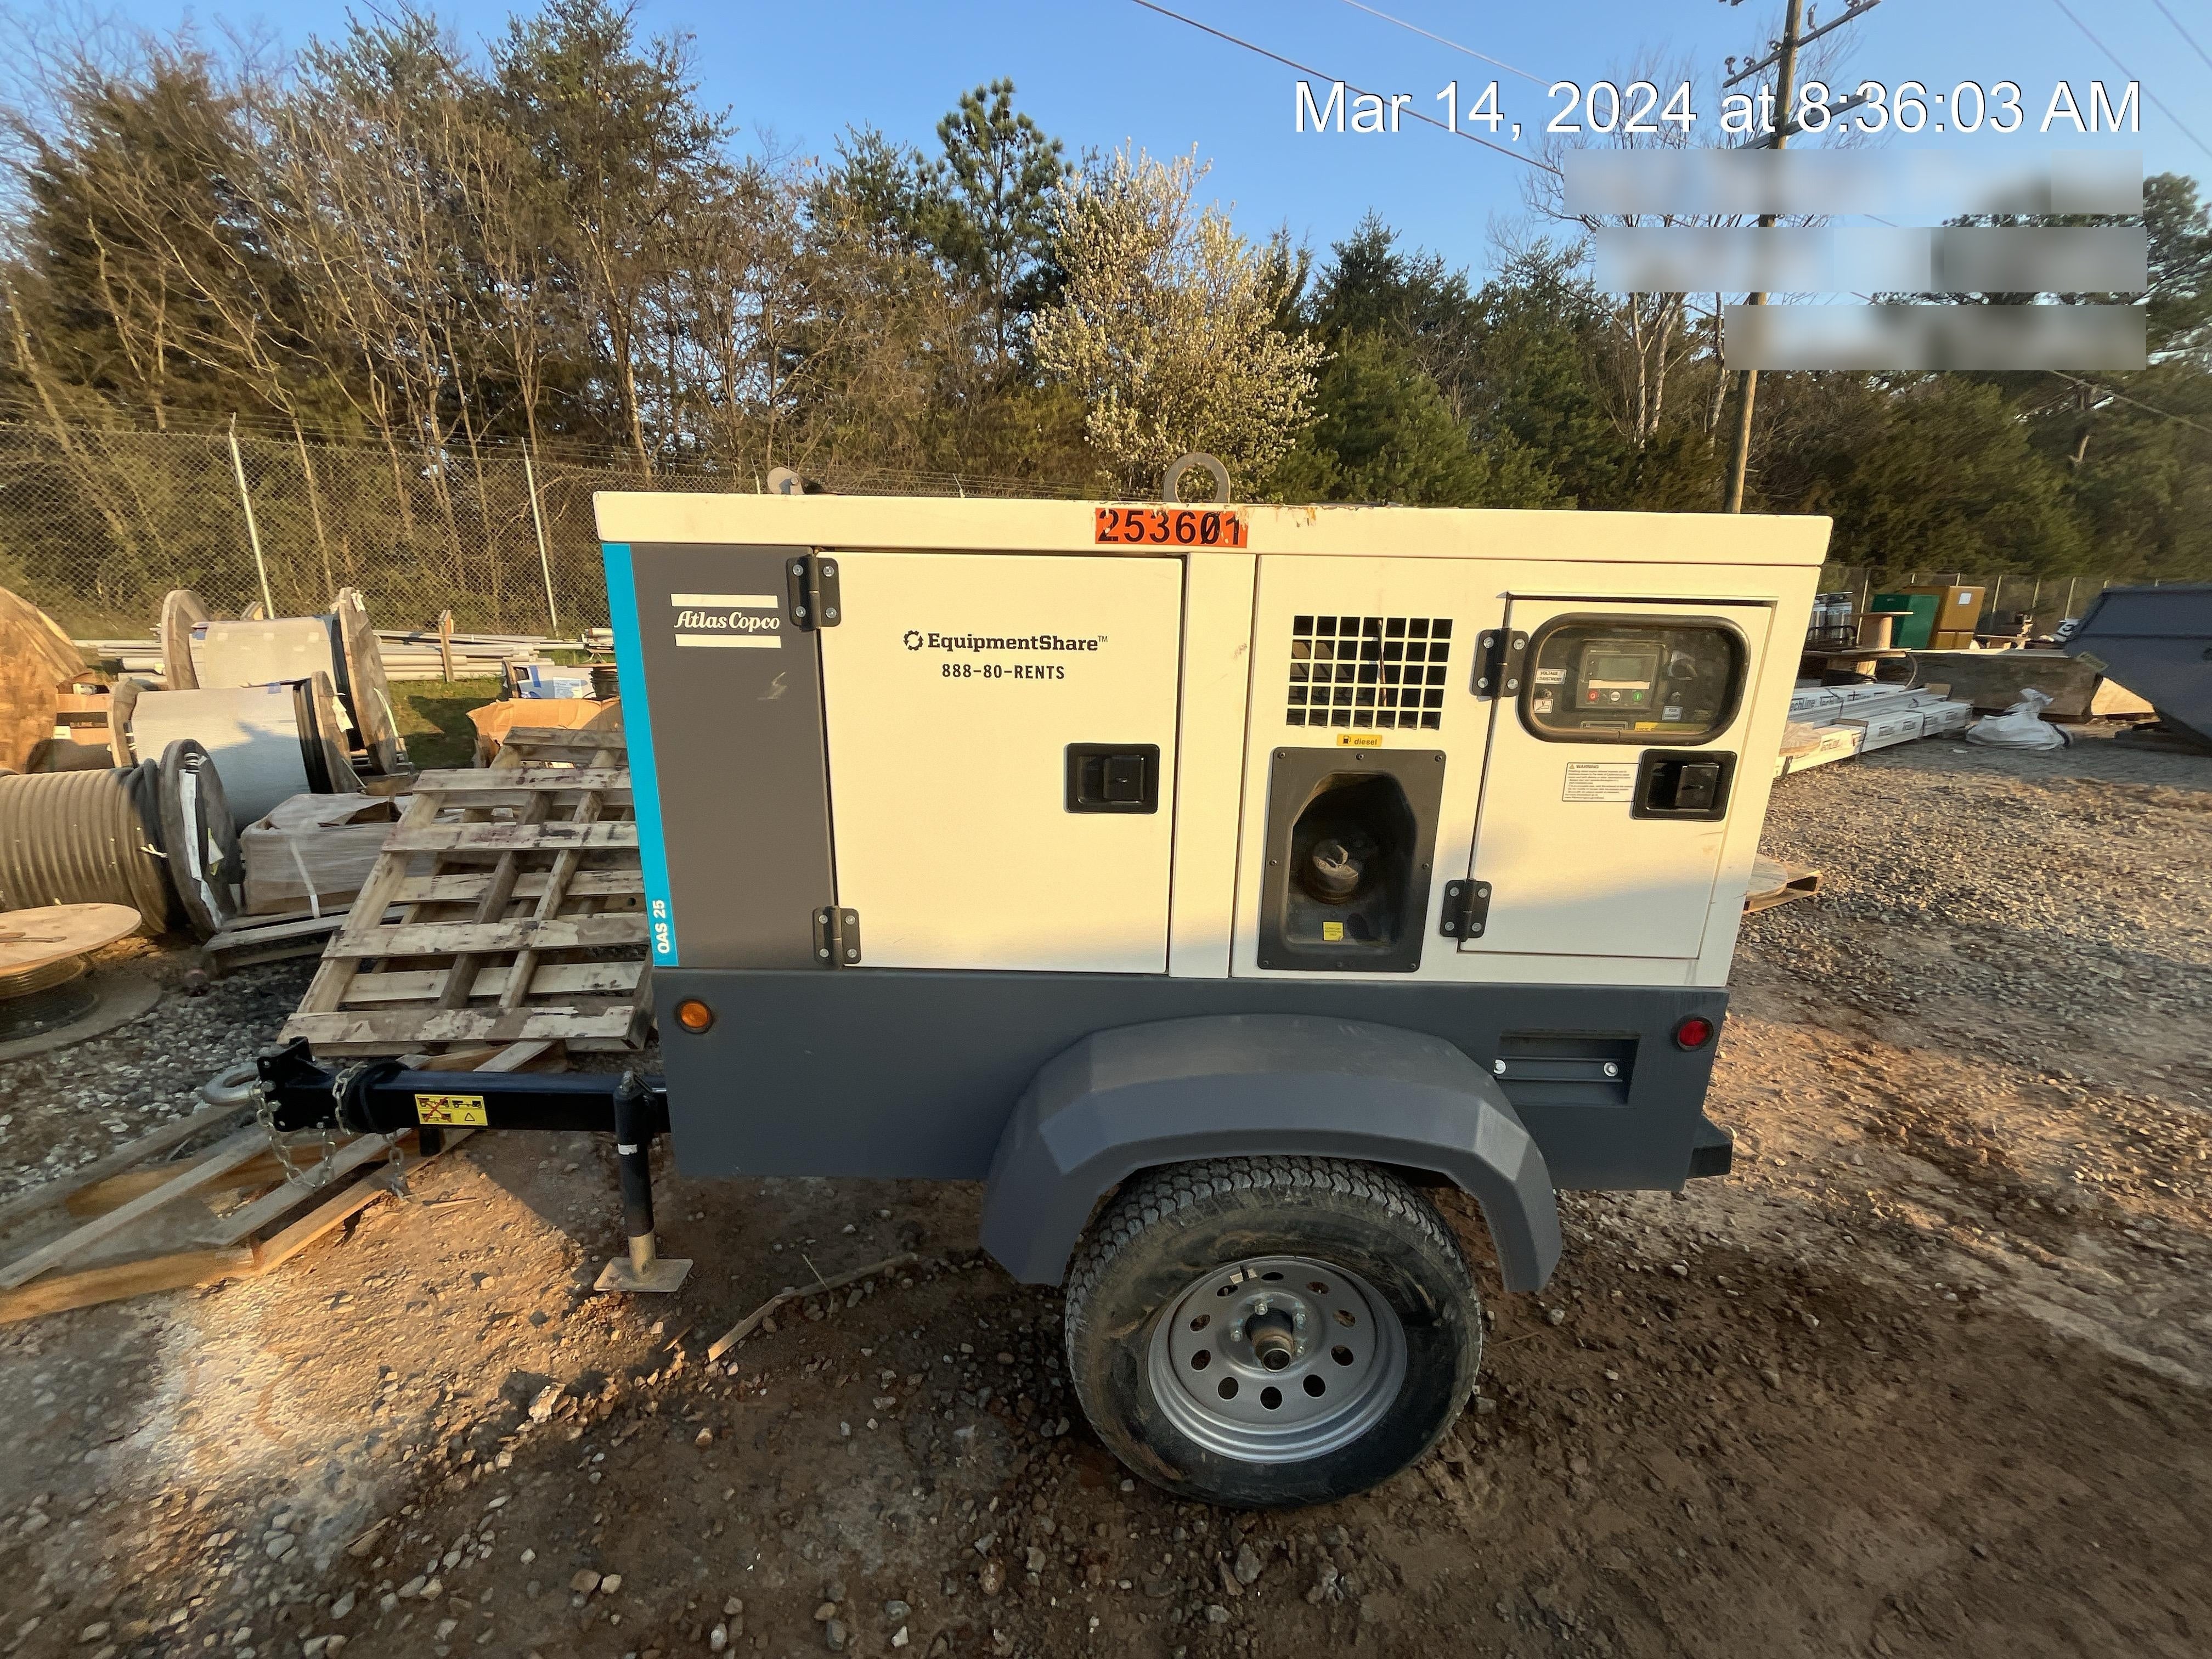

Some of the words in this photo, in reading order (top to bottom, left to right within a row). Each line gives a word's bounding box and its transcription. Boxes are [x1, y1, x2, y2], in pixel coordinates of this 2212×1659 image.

[1098, 509, 1239, 545] 253601
[674, 611, 727, 629] Atlas
[729, 611, 780, 632] Copco
[941, 663, 1065, 680] 888-80-RENTS
[1354, 737, 1378, 746] diesel
[652, 900, 666, 919] 25
